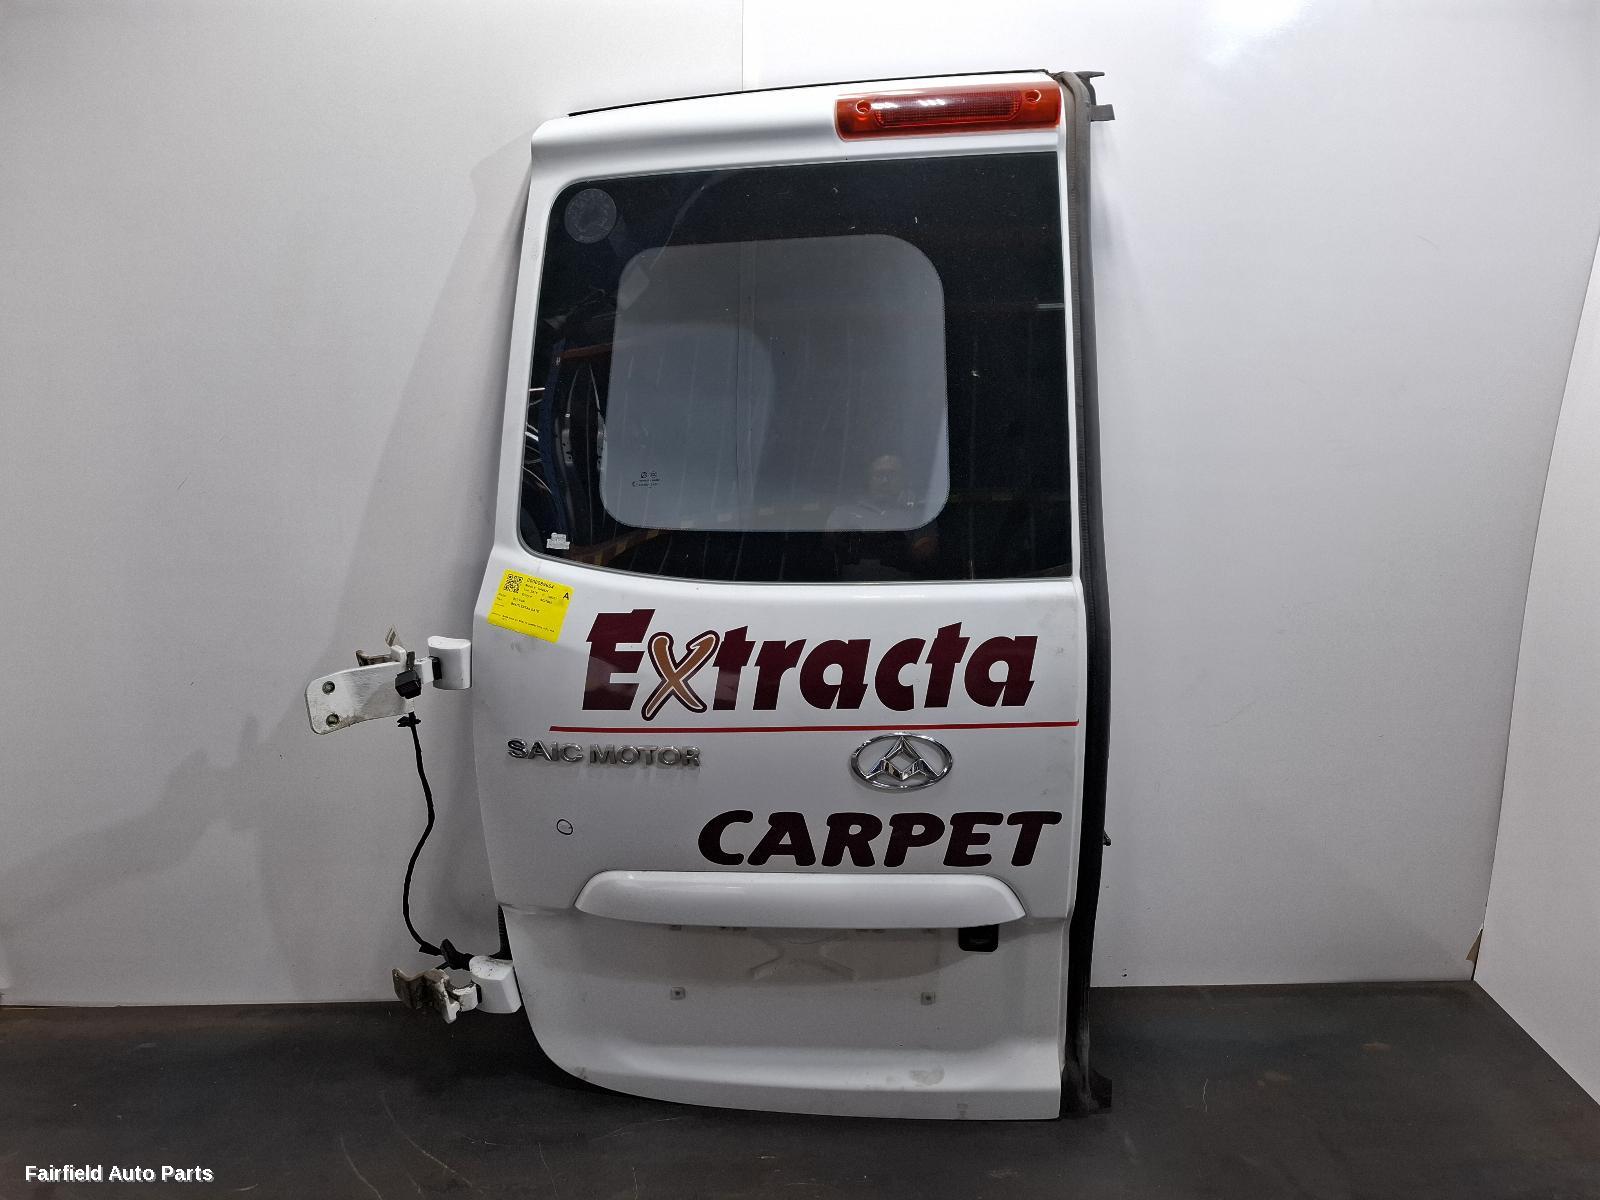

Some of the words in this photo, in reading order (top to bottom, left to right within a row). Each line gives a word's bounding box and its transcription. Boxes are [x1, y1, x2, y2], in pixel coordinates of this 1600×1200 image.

[562, 592, 570, 600] A
[582, 608, 1038, 721] Extracta
[507, 738, 584, 766] SAIC
[589, 742, 702, 768] MOTOR
[698, 809, 1063, 868] CARPET
